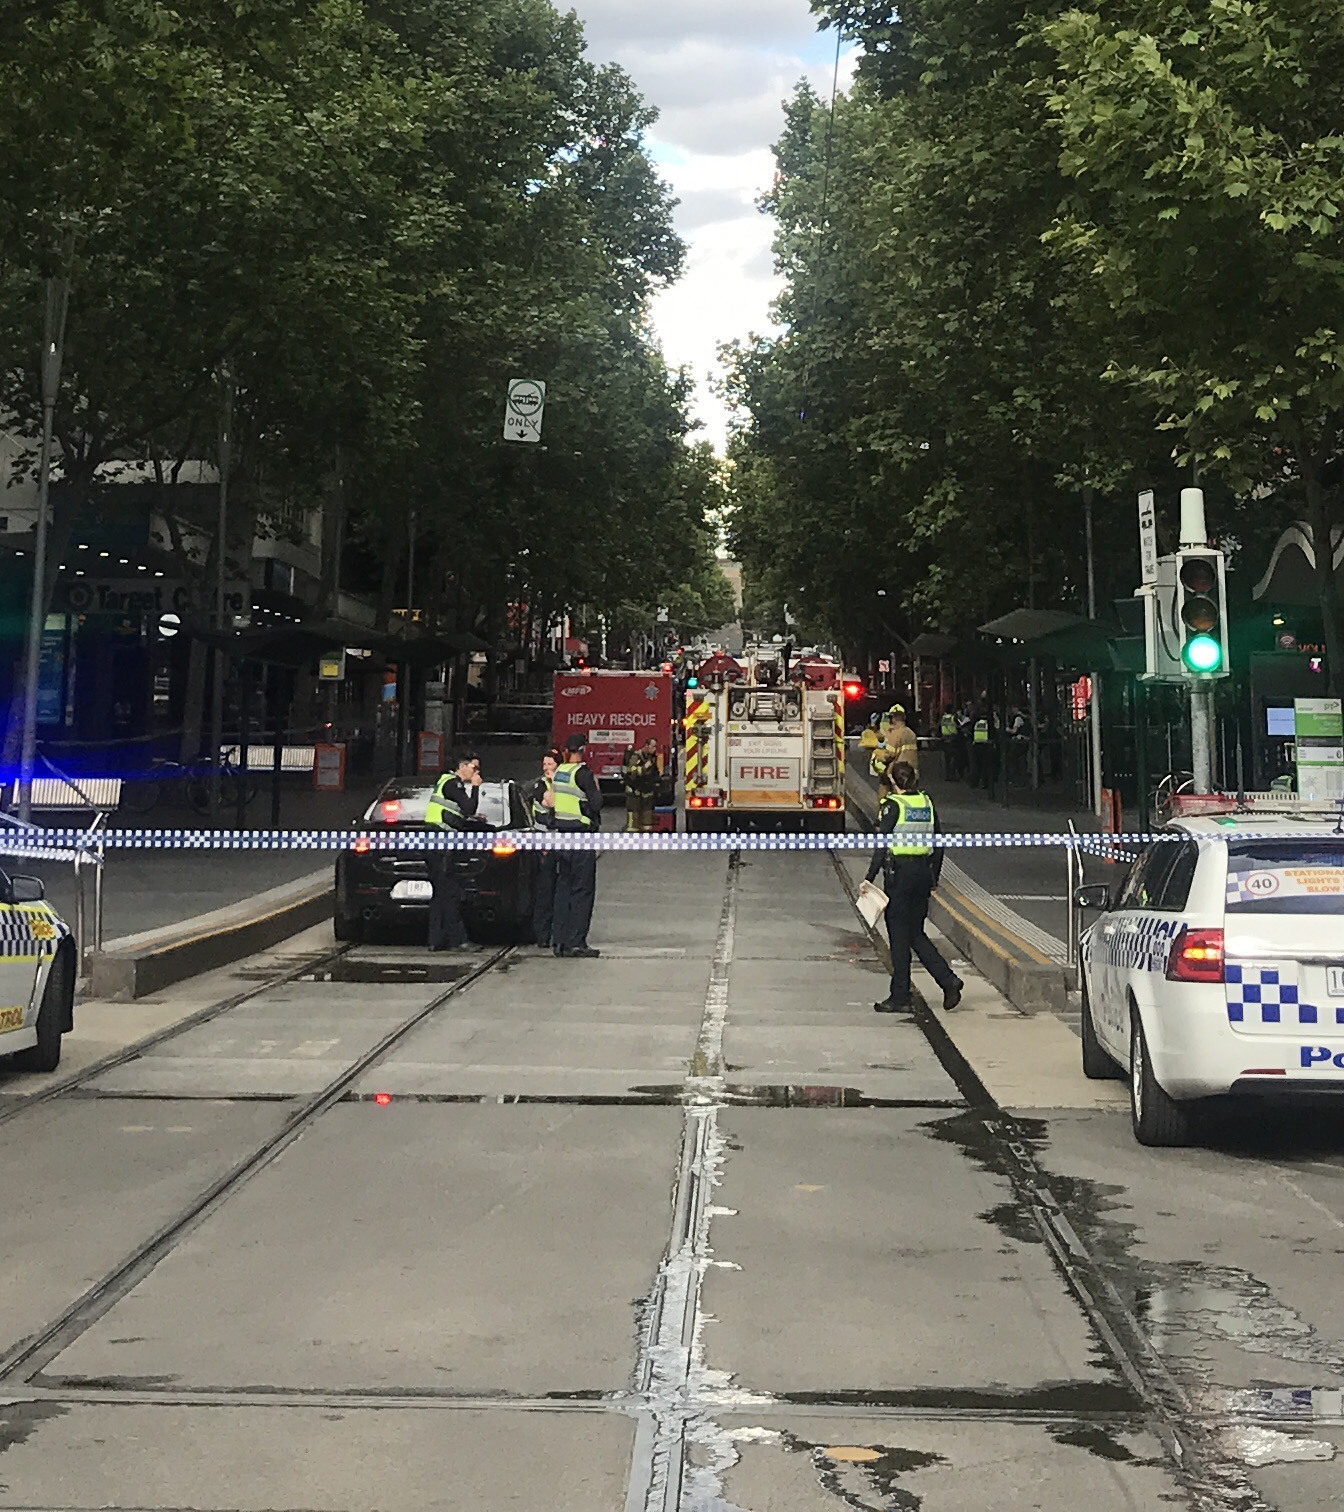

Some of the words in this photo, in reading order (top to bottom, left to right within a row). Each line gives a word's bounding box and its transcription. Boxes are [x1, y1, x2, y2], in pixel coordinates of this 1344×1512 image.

[507, 417, 539, 428] ONLY
[567, 713, 606, 726] HEAVY
[609, 713, 657, 727] RESCUE
[739, 766, 790, 780] FIRE
[1251, 878, 1273, 890] 40
